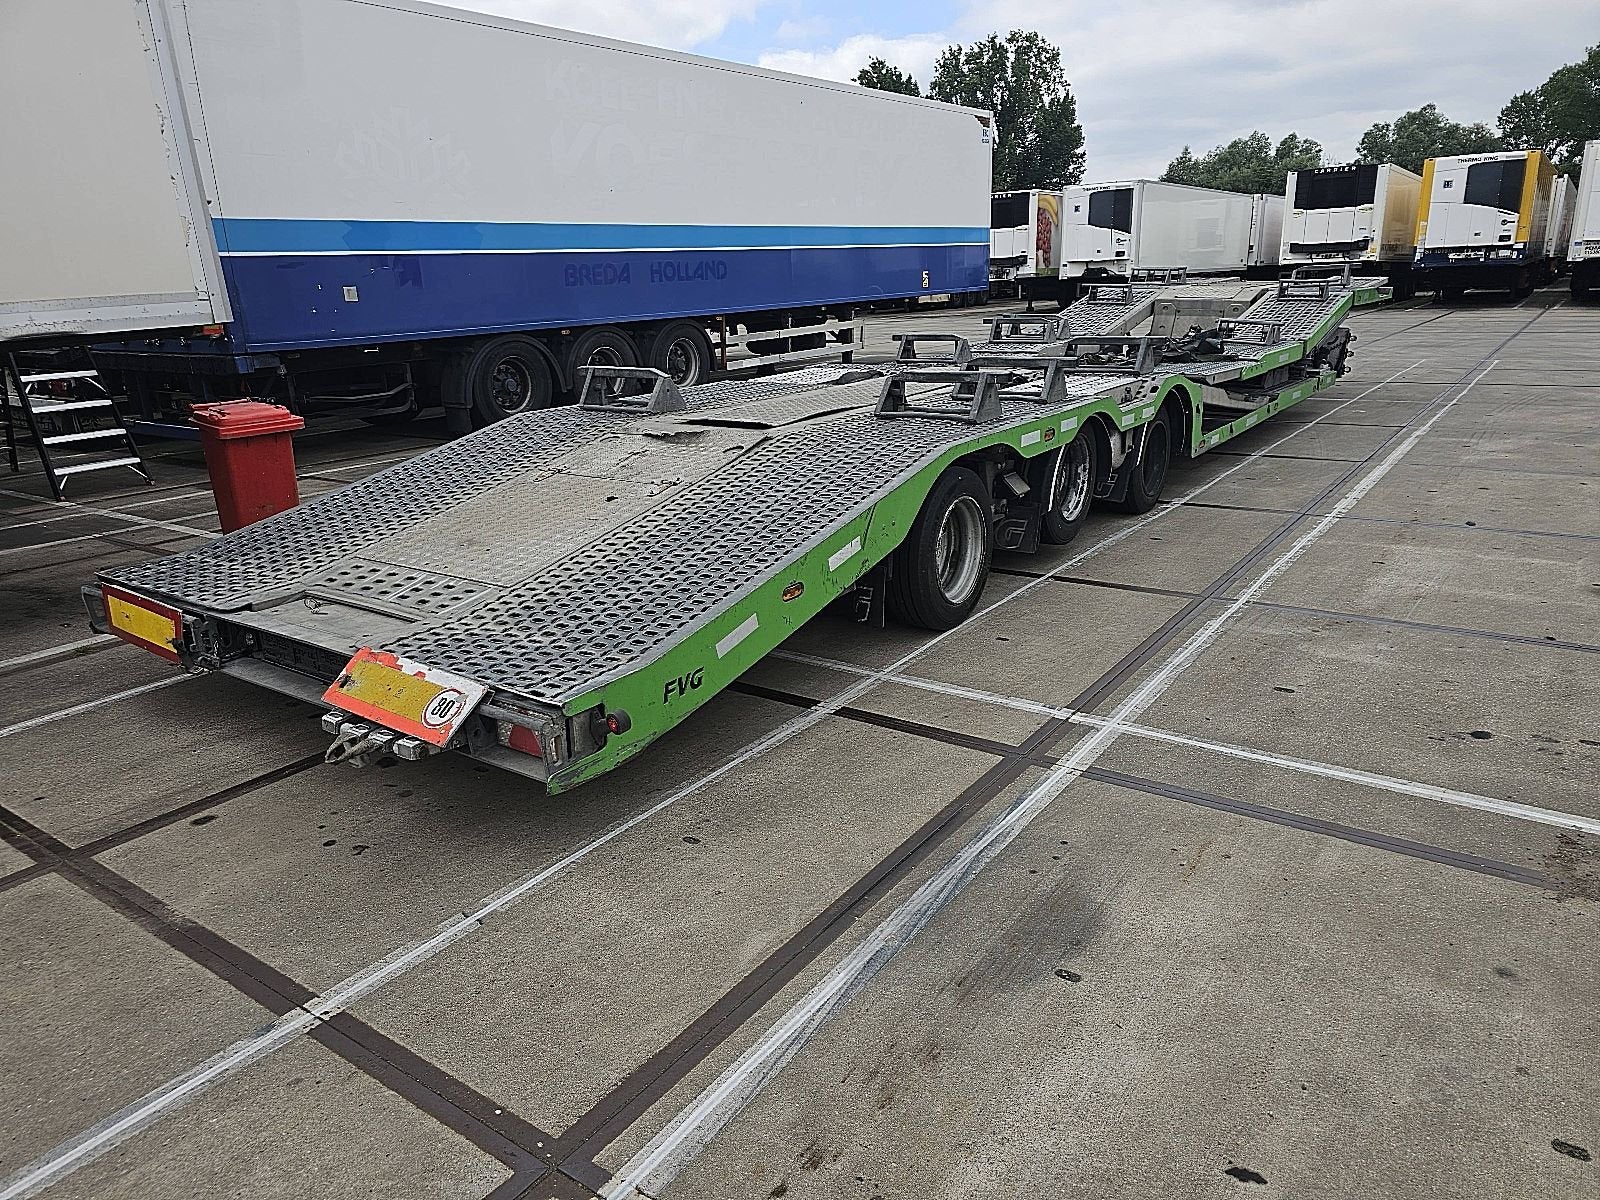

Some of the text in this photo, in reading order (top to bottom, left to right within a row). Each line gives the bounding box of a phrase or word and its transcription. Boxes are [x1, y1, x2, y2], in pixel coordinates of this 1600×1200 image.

[1314, 166, 1357, 174] CARRIER
[564, 260, 728, 287] BREDA HOLLAND
[663, 667, 704, 704] FVG
[431, 697, 455, 718] 80
